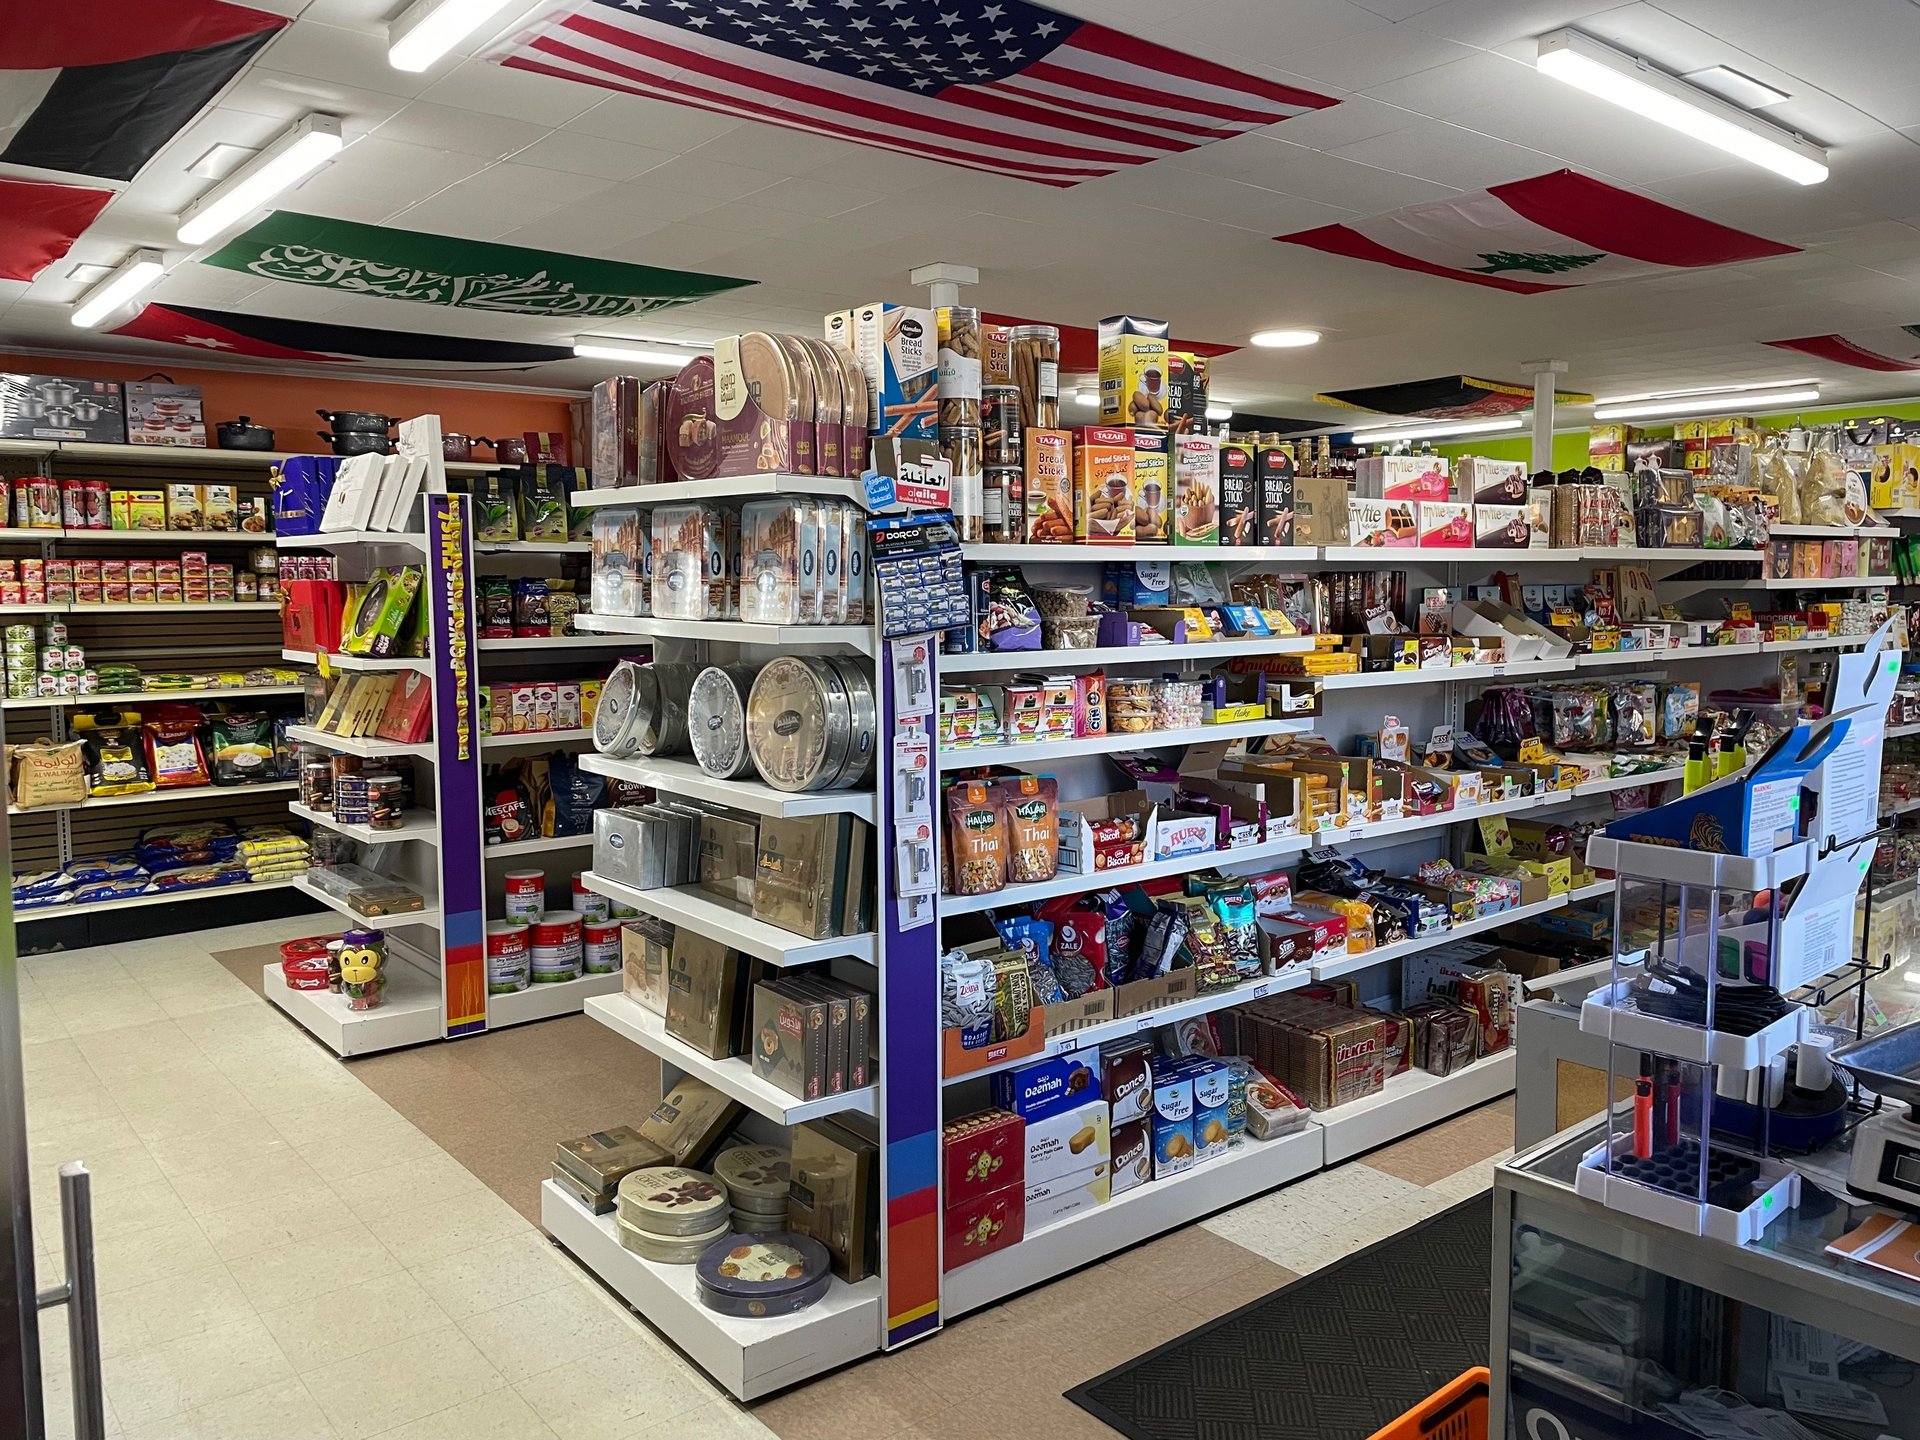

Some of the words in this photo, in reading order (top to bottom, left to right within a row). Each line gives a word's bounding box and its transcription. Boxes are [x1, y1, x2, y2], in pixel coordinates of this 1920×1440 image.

[901, 337, 923, 348] Bread
[990, 333, 1008, 341] TAZ
[901, 346, 923, 356] Sticks
[990, 349, 1007, 359] Bre
[1133, 345, 1149, 353] Bread
[1149, 344, 1165, 353] Sticks
[990, 361, 1008, 371] Stic
[1168, 386, 1183, 398] READ
[1168, 398, 1182, 409] ICKS
[1040, 436, 1065, 445] TAZAH
[1098, 432, 1124, 440] TAZAH
[1135, 438, 1159, 446] TAZAH
[1039, 453, 1065, 464] Bread
[1094, 456, 1112, 464] Bread
[1113, 454, 1131, 463] Sticks
[1135, 461, 1149, 469] read
[1149, 459, 1165, 467] Sticks
[1038, 465, 1066, 475] Sticks
[900, 467, 946, 487] العائلة
[1224, 479, 1244, 491] BREAD
[1264, 480, 1283, 492] BREAD
[908, 488, 937, 500] alaila
[1224, 491, 1243, 502] STICKS
[1265, 492, 1283, 503] STICKS
[886, 529, 920, 540] DORCO
[1140, 570, 1160, 580] Sugar
[1365, 604, 1386, 619] Dance
[1232, 708, 1251, 719] flake
[1018, 804, 1046, 816] HALABI
[967, 814, 994, 826] HALABI
[1023, 826, 1050, 842] Thai
[1099, 829, 1121, 843] Biscoff
[971, 836, 999, 853] Thai
[1107, 853, 1131, 867] Biscoff
[1315, 849, 1337, 860] NESS
[1060, 942, 1078, 950] ZALE
[960, 983, 980, 996] Zeina
[1336, 1039, 1375, 1064] ÜLKER
[1025, 1077, 1062, 1099] Deemah
[1115, 1073, 1145, 1098] Dance
[1199, 1086, 1219, 1100] Sugar
[1211, 1092, 1225, 1103] Free
[1160, 1100, 1182, 1113] Sugar
[1174, 1105, 1190, 1116] Free
[1031, 1138, 1060, 1153] Deemah
[1030, 1152, 1043, 1160] Curvy
[1115, 1142, 1144, 1168] Dance
[1026, 1188, 1051, 1202] Deemah
